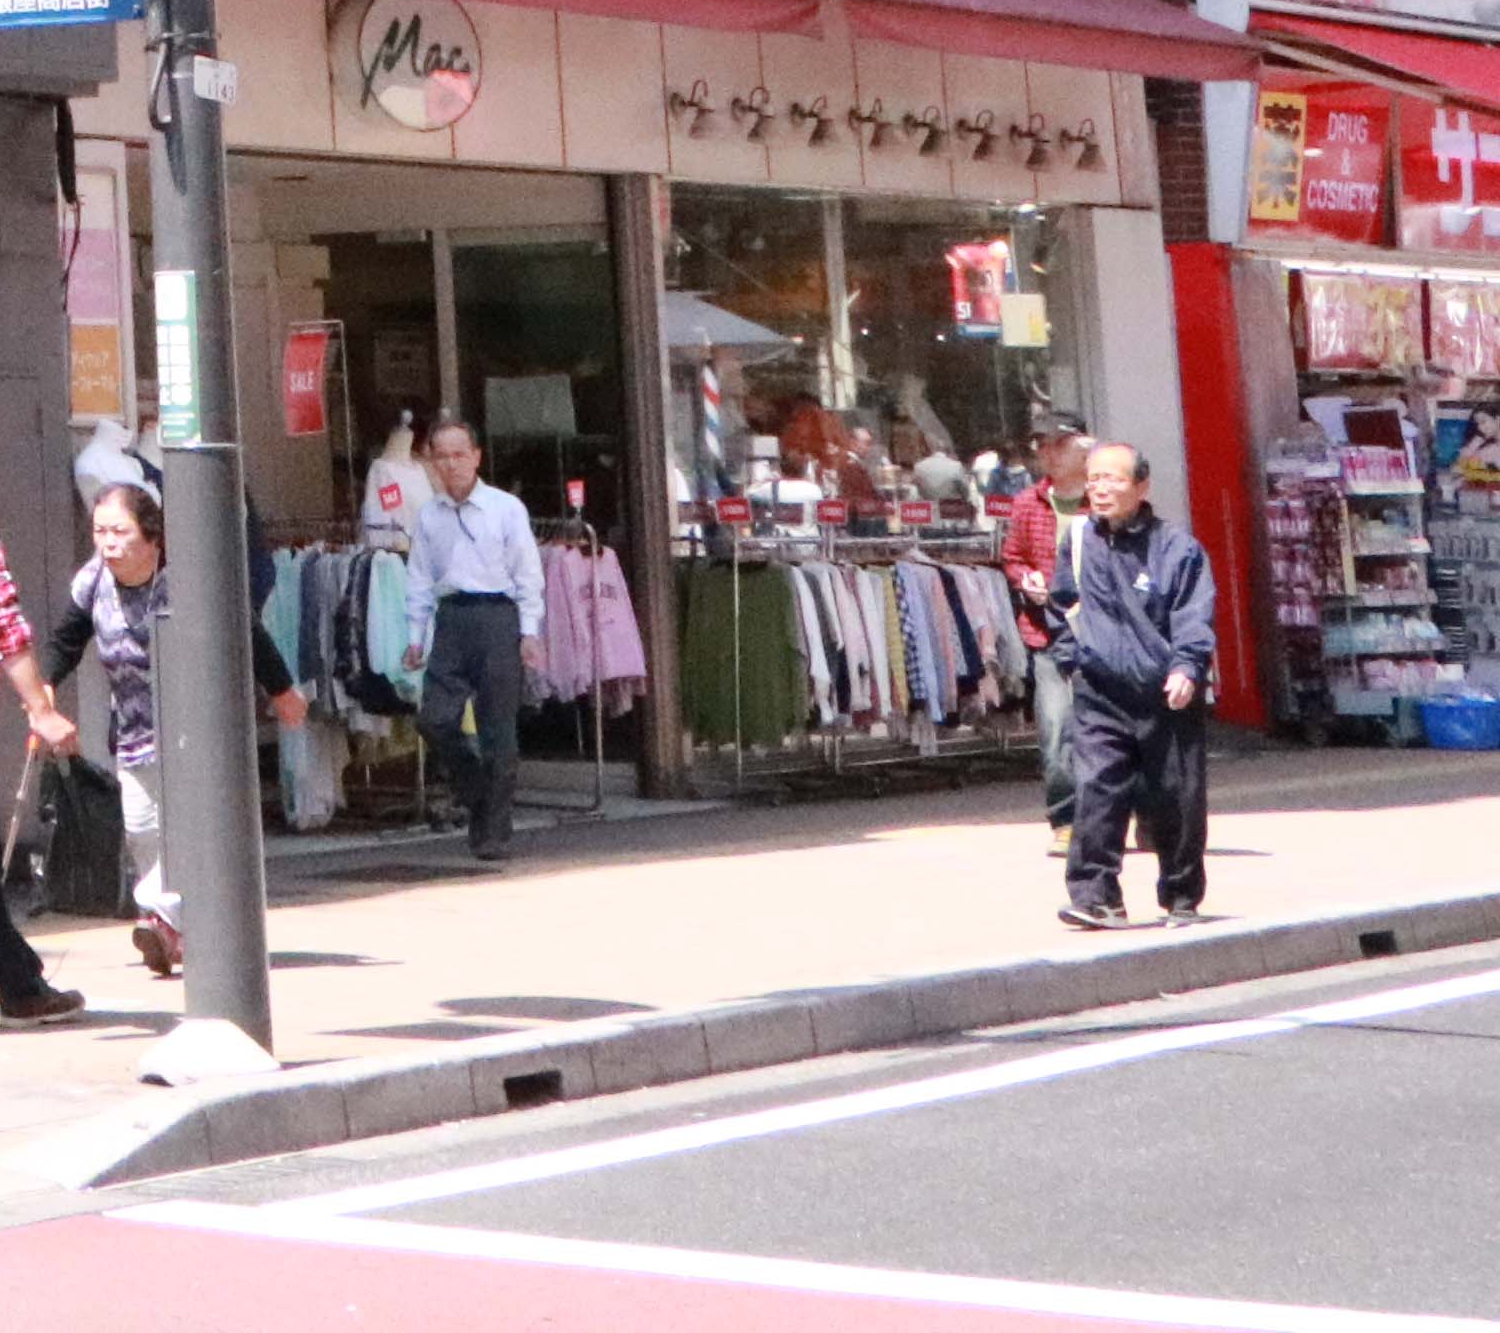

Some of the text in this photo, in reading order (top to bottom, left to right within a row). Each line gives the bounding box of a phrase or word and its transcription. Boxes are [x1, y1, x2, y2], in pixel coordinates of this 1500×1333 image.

[1326, 110, 1369, 145] DRUG
[1306, 179, 1380, 213] COSMETIC
[290, 367, 315, 393] SALE
